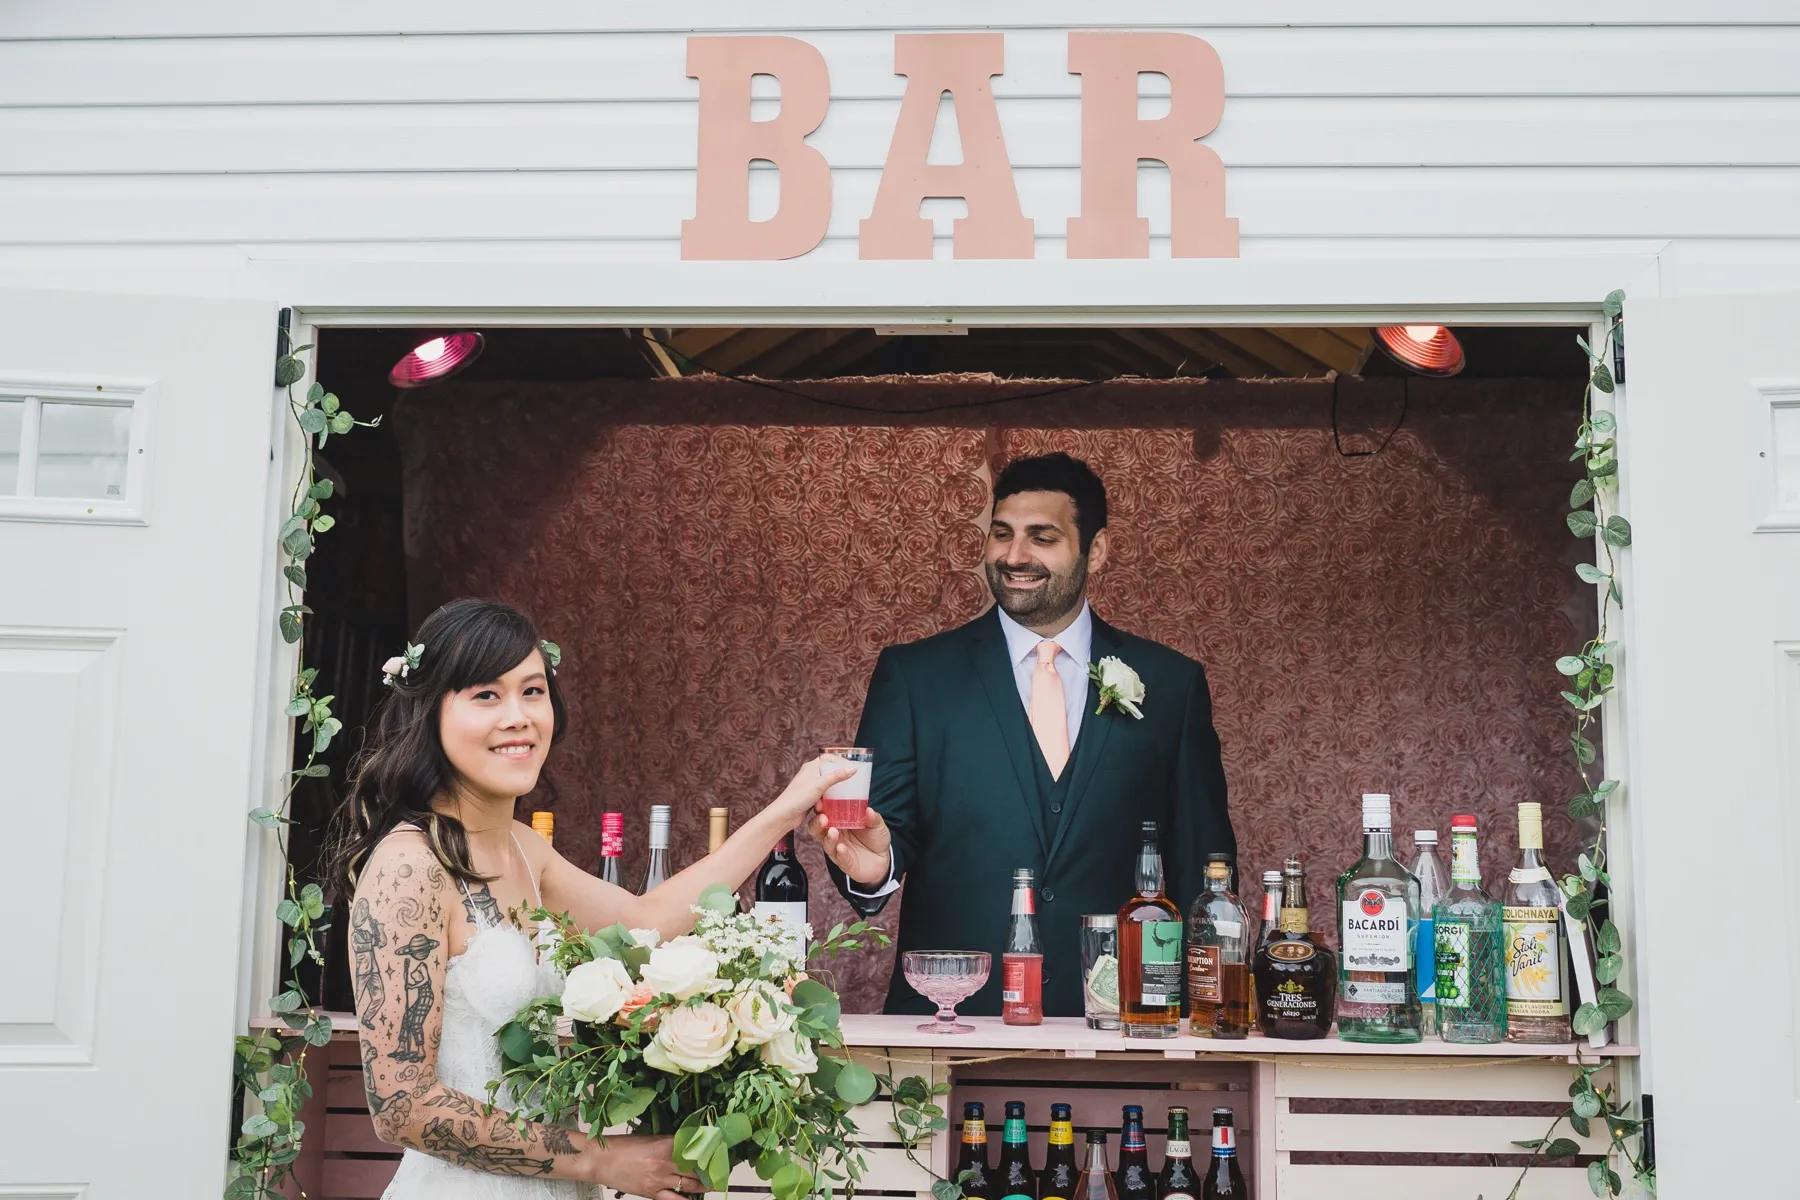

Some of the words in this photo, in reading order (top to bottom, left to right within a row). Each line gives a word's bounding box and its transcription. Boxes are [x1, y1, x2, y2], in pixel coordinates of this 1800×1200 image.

[681, 32, 1240, 260] BAR
[1502, 908, 1555, 919] TOLICHNAYA
[1348, 916, 1400, 931] BACARDÍ
[1513, 936, 1537, 959] Stoli
[1510, 949, 1544, 977] Vanil
[1267, 999, 1317, 1008] GENERACIONES
[1279, 993, 1303, 1002] TRES
[1169, 1145, 1189, 1153] LAGER
